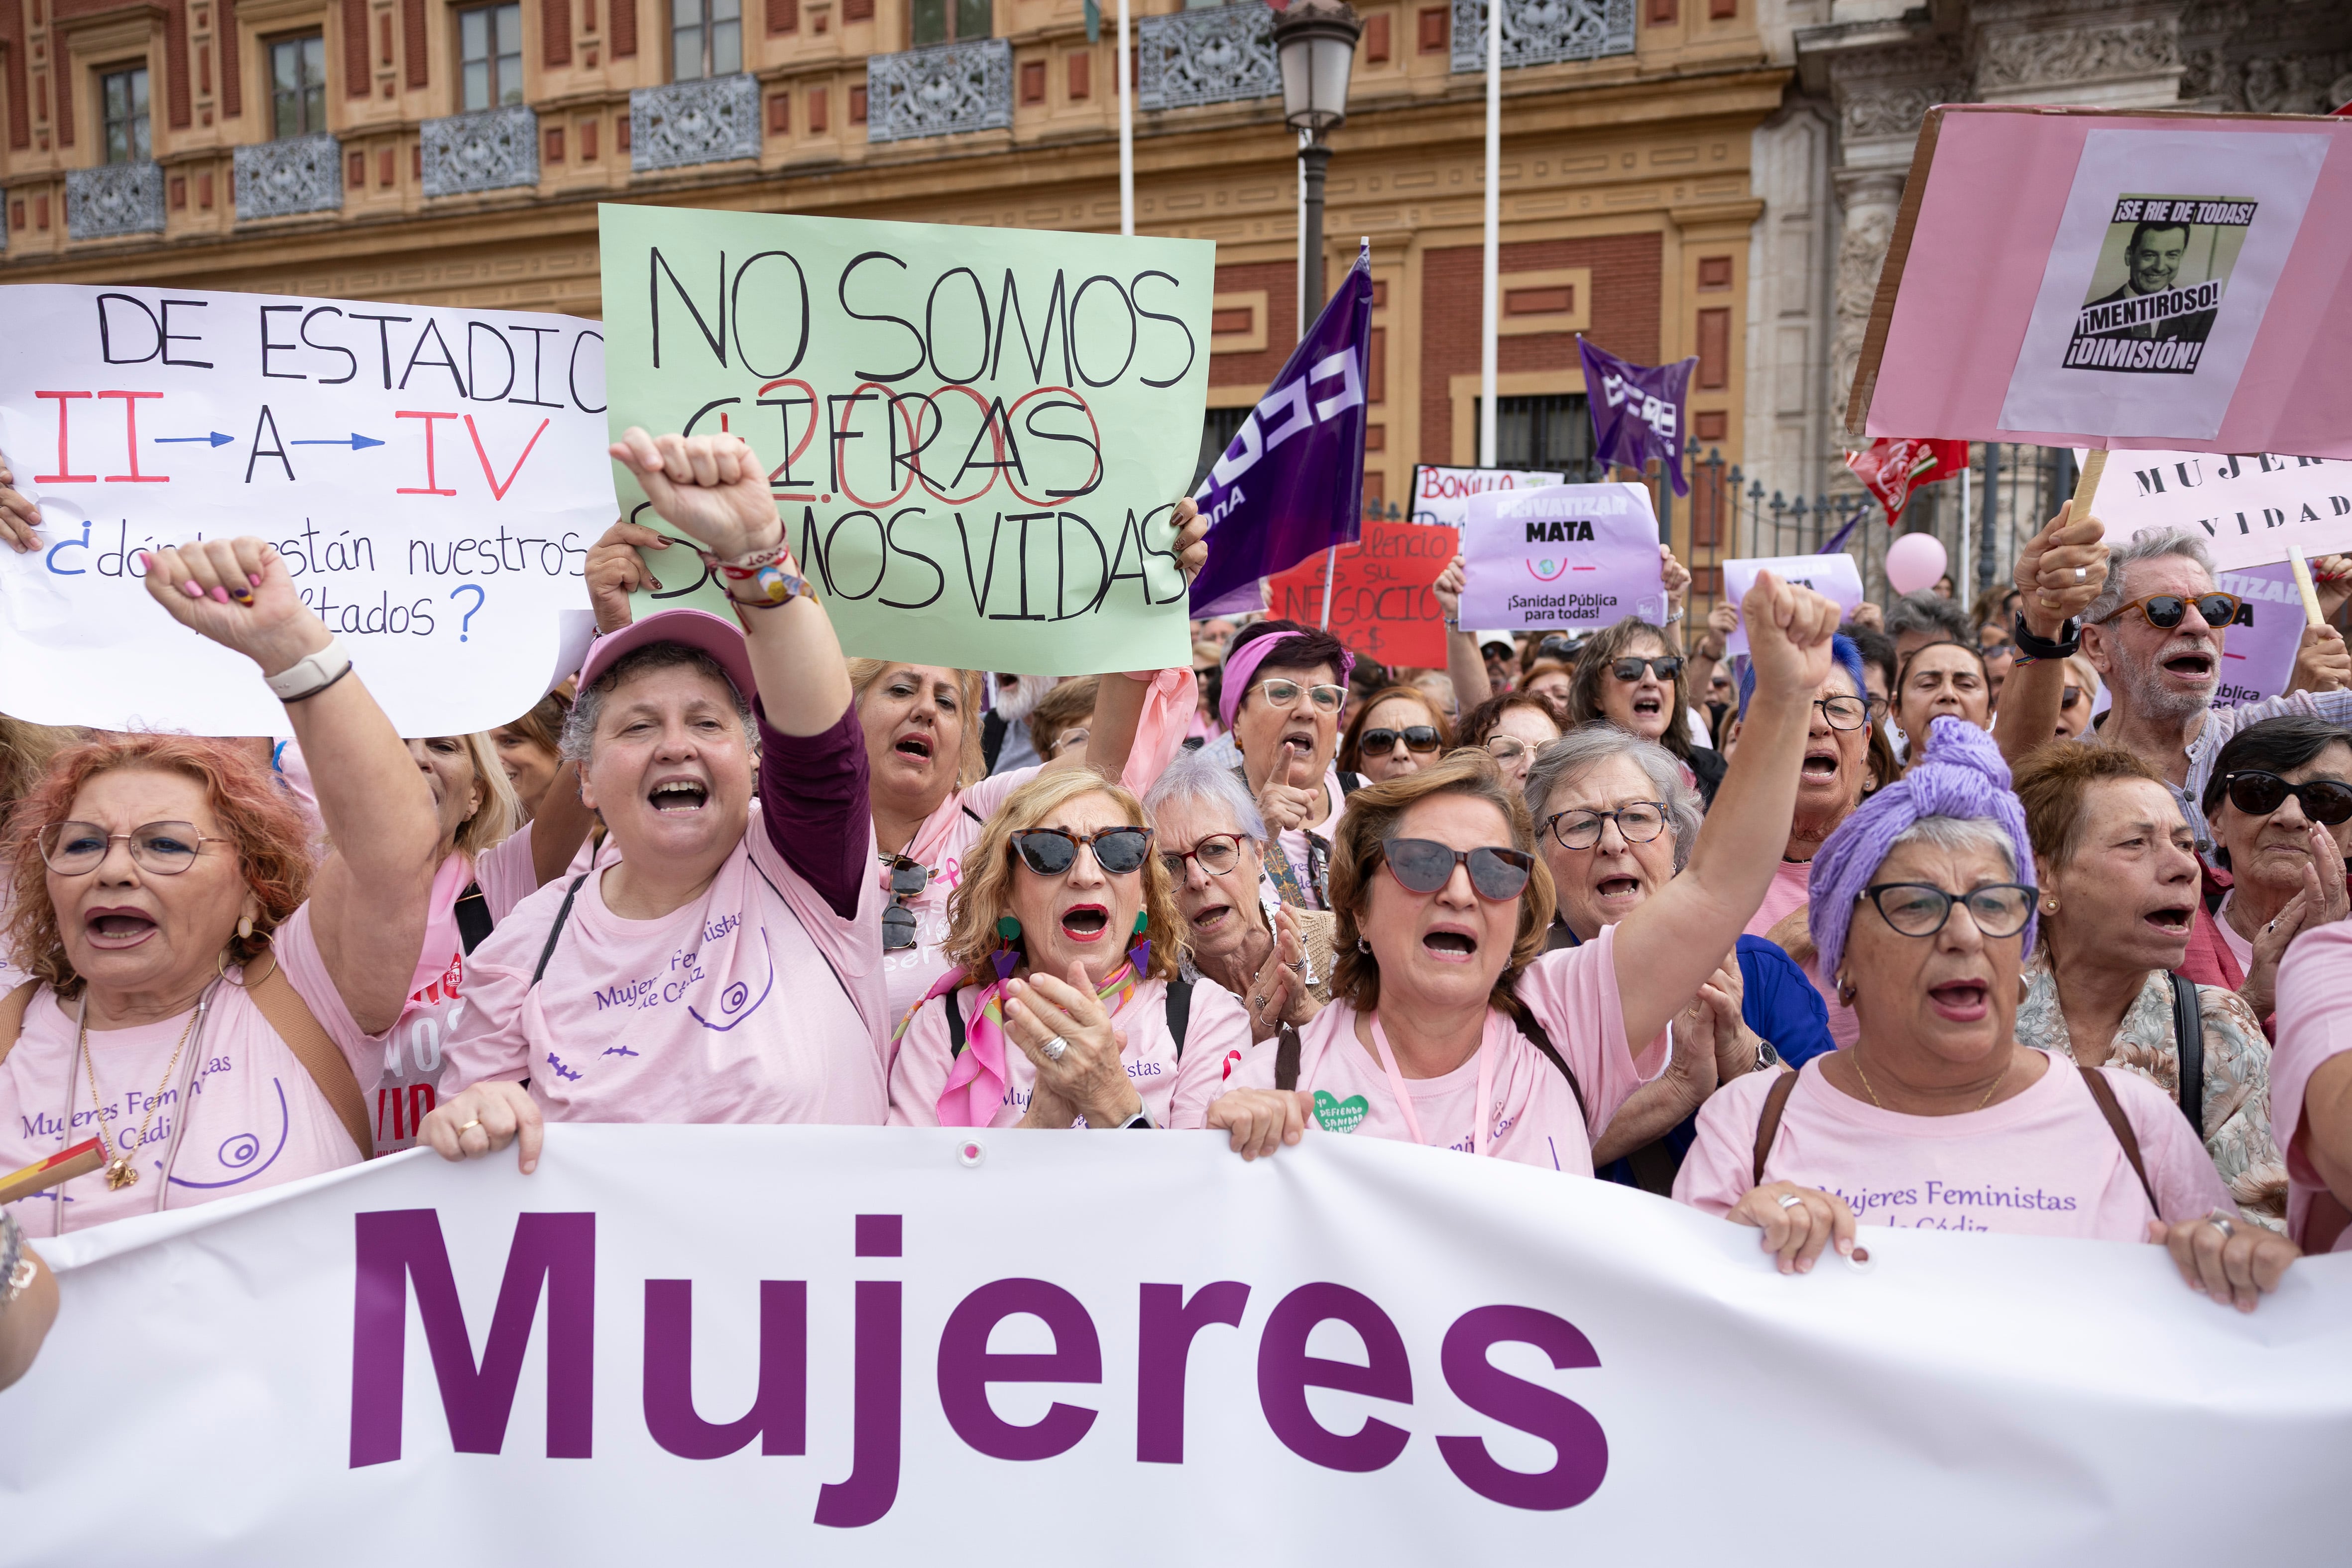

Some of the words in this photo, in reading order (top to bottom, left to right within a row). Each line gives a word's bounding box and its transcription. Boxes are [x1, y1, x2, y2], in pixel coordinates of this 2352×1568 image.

[2115, 200, 2143, 221] ¡SE
[2142, 201, 2172, 222] RIE
[2170, 201, 2197, 223] DE
[2195, 202, 2255, 224] TODAS!
[650, 245, 810, 378] NO
[838, 251, 1195, 388] SOMOS
[2082, 281, 2219, 334] ¡MENTIROSO!
[96, 293, 214, 369] DE
[2066, 335, 2203, 370] ¡DIMISIÓN!
[244, 404, 295, 483] A
[395, 410, 550, 501] IV
[1496, 496, 1628, 519] PRIVATIZAR
[1526, 521, 1595, 542] MATA
[409, 525, 588, 576] nuestros
[953, 502, 1187, 621] VIDAS
[1285, 583, 1443, 626] NEGOCIO
[1508, 595, 1566, 611] ¡Sanidad
[1569, 593, 1618, 606] Pública
[1525, 608, 1555, 622] para
[1558, 606, 1600, 620] todas!
[1319, 1106, 1363, 1117] DEFIENDO
[1324, 1113, 1363, 1127] SANIDAD
[1925, 1180, 2077, 1211] Feministas
[350, 1208, 1608, 1528] Mujeres
